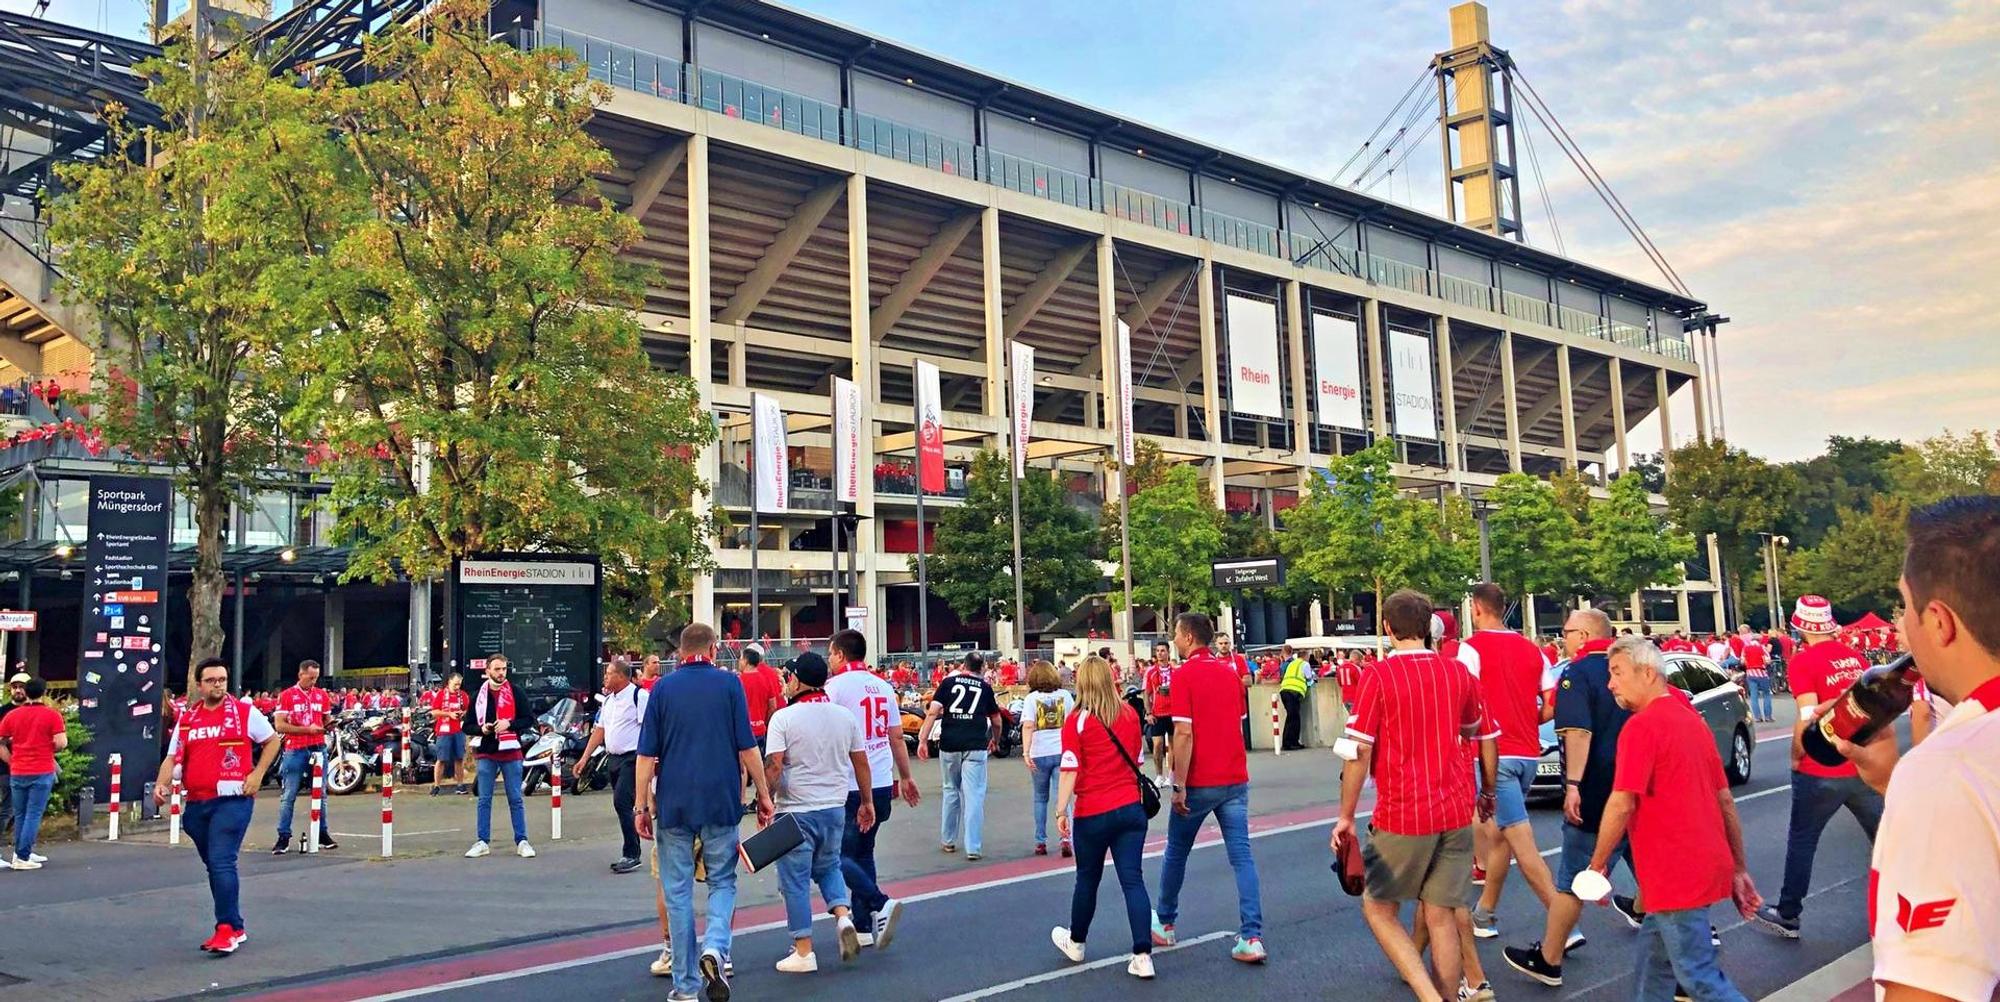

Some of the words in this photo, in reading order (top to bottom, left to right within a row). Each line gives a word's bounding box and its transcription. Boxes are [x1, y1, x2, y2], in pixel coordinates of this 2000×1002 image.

[1241, 367, 1270, 385] Rhein
[1322, 380, 1356, 400] Energie
[1395, 392, 1432, 411] STADION
[97, 489, 146, 502] Sportpark
[97, 501, 163, 514] Müngersdorf
[464, 567, 566, 580] RheinEnergieSTADION
[1235, 575, 1255, 583] Zufahrt
[955, 677, 982, 687] MODESTE
[949, 684, 982, 715] 27
[860, 696, 889, 741] 15
[188, 725, 222, 742] REW
